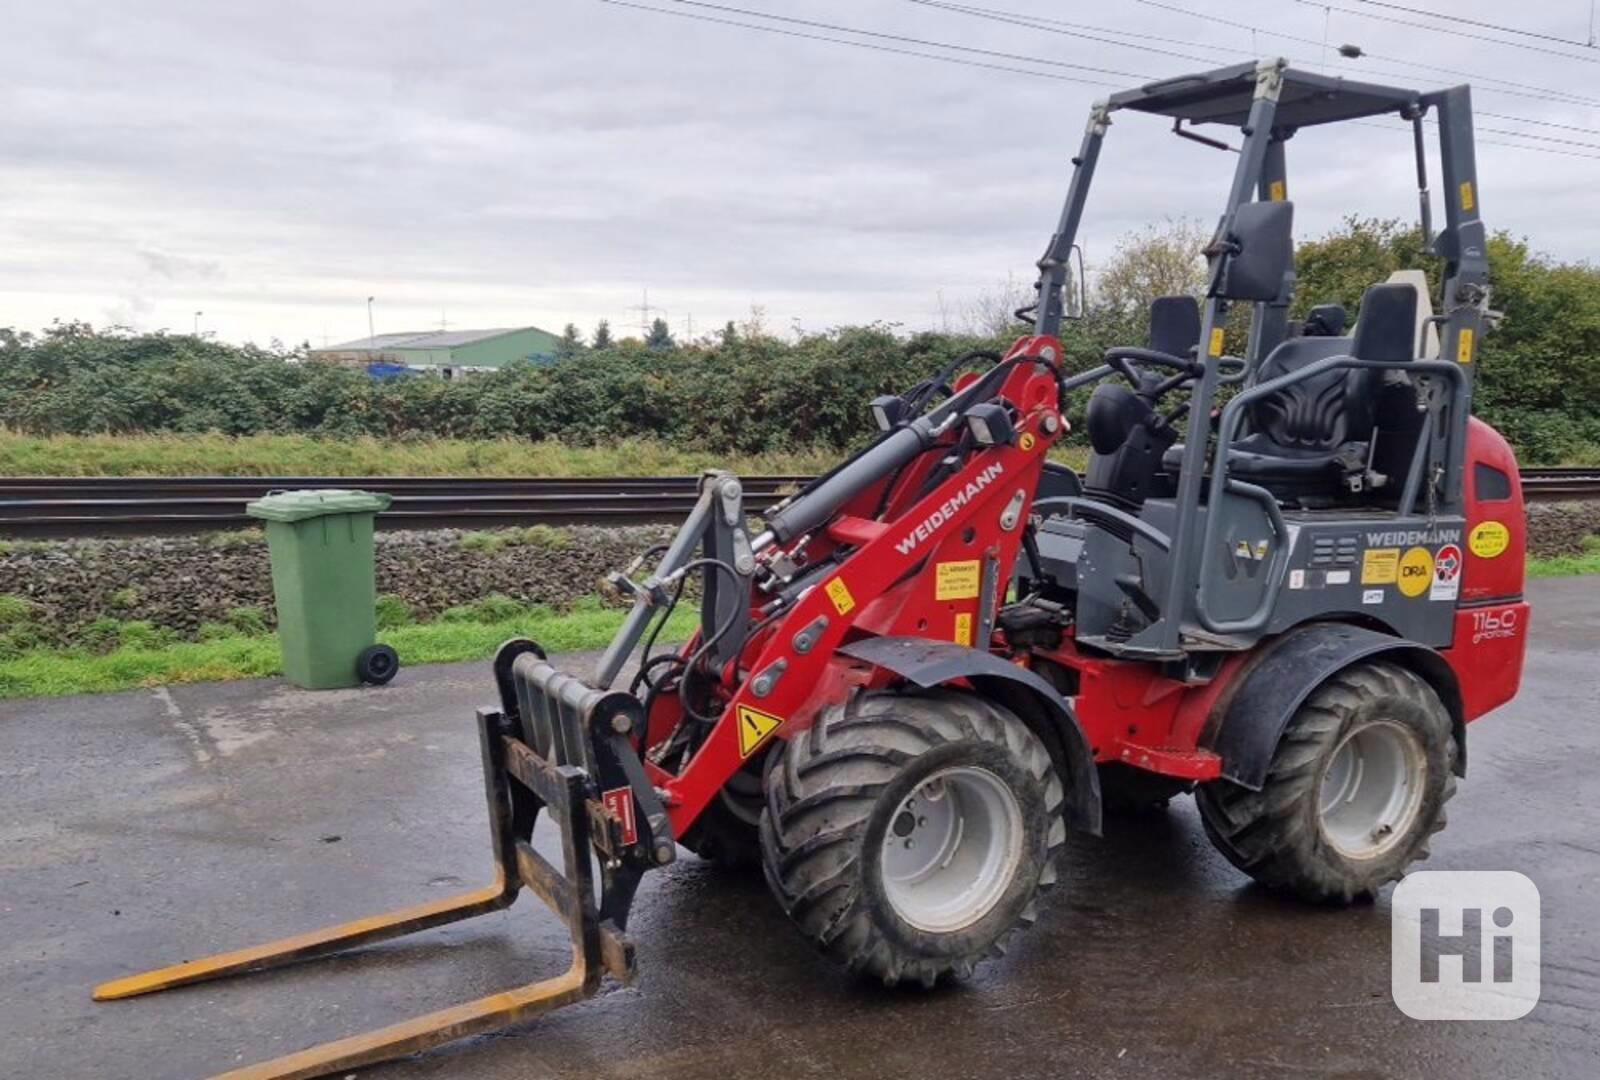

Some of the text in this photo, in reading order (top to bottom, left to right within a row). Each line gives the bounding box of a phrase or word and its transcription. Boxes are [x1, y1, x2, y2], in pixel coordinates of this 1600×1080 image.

[895, 461, 1004, 555] WEIDEMANN
[1366, 529, 1460, 547] WEIDEMANN
[1472, 609, 1518, 631] 1160
